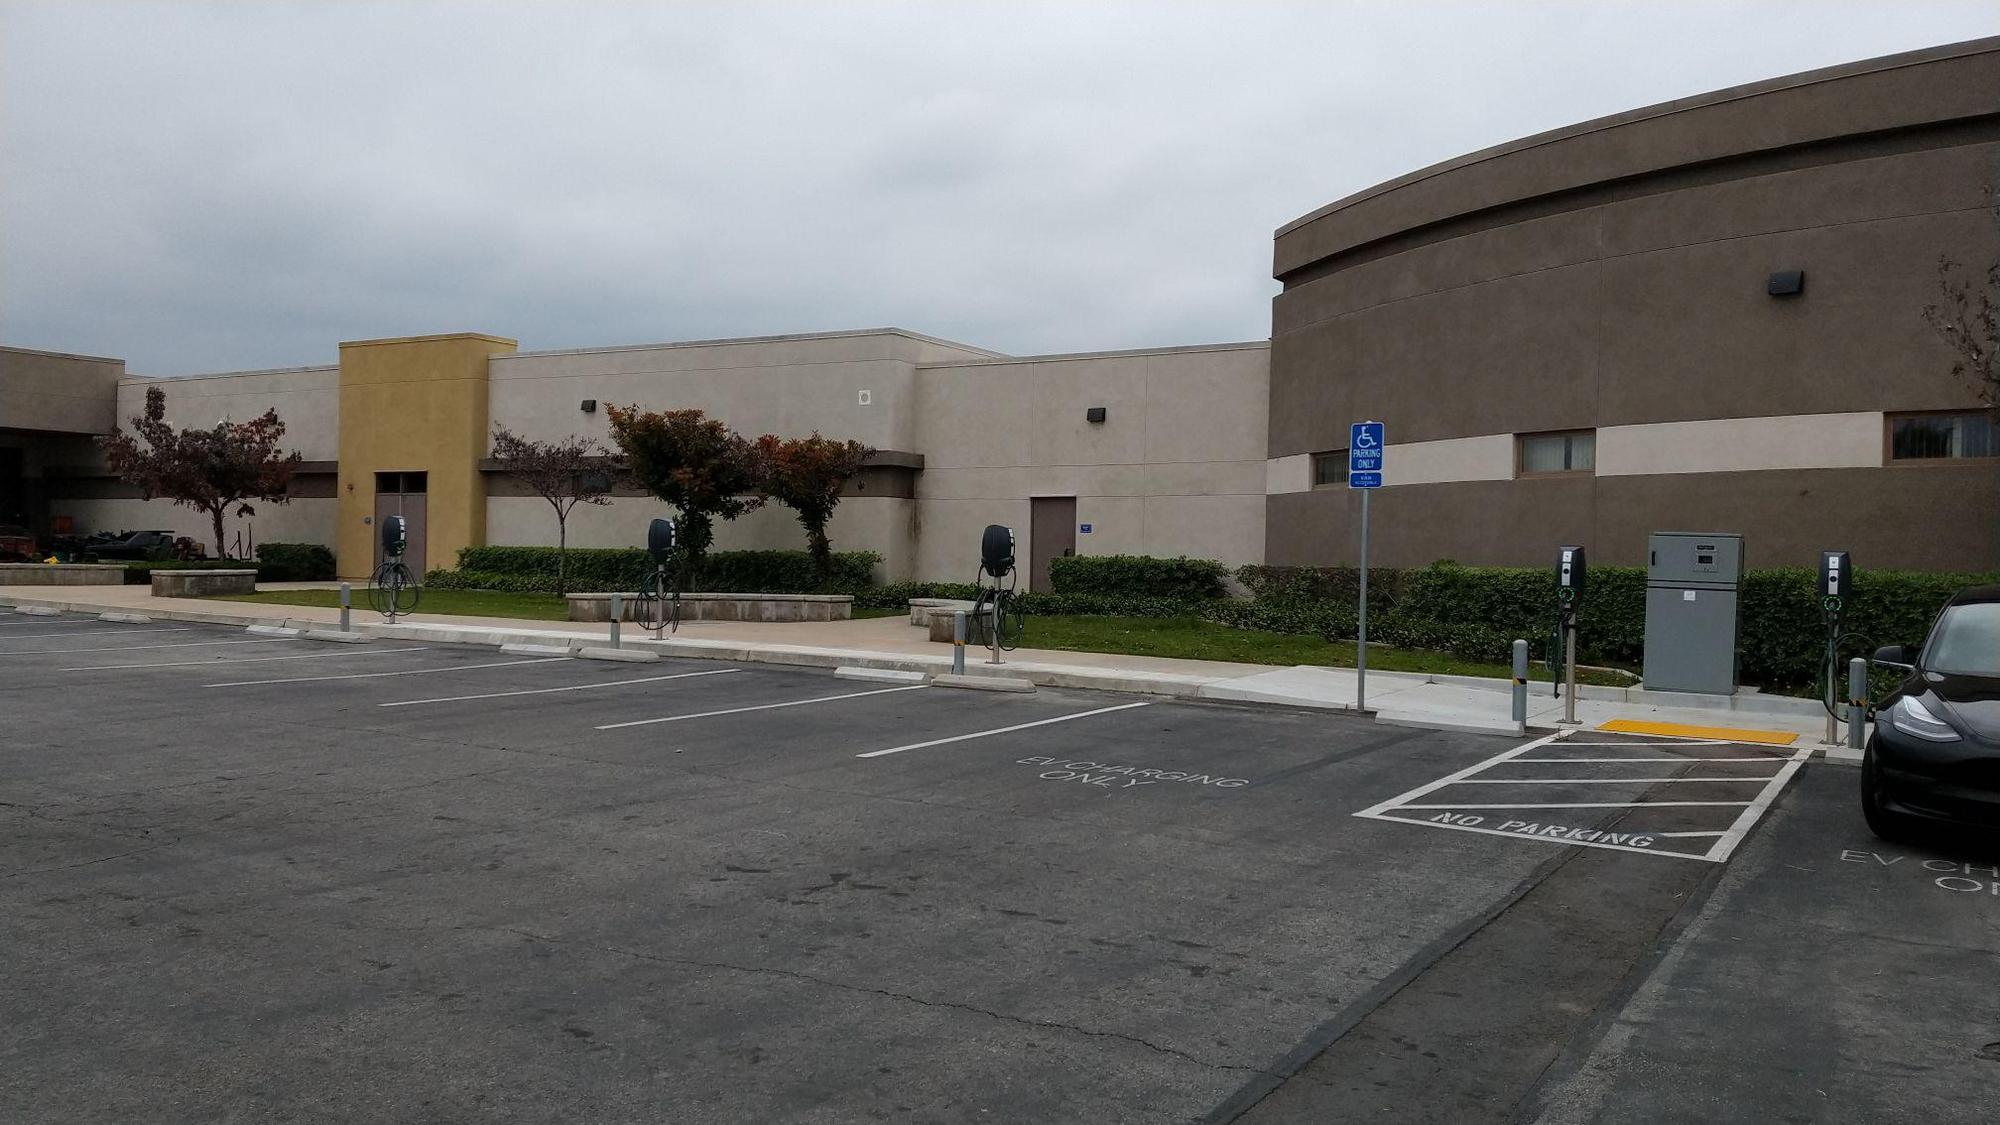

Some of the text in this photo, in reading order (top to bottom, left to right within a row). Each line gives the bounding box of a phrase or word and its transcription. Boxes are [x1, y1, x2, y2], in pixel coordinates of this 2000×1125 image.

[1353, 448, 1381, 458] PARKING
[1358, 459, 1375, 469] ONLY
[1016, 756, 1249, 788] EV CHARGING
[1039, 770, 1156, 789] ONLY
[1430, 812, 1655, 847] NO PARKING
[1840, 849, 1999, 878] EV CH
[1935, 876, 2000, 896] O
